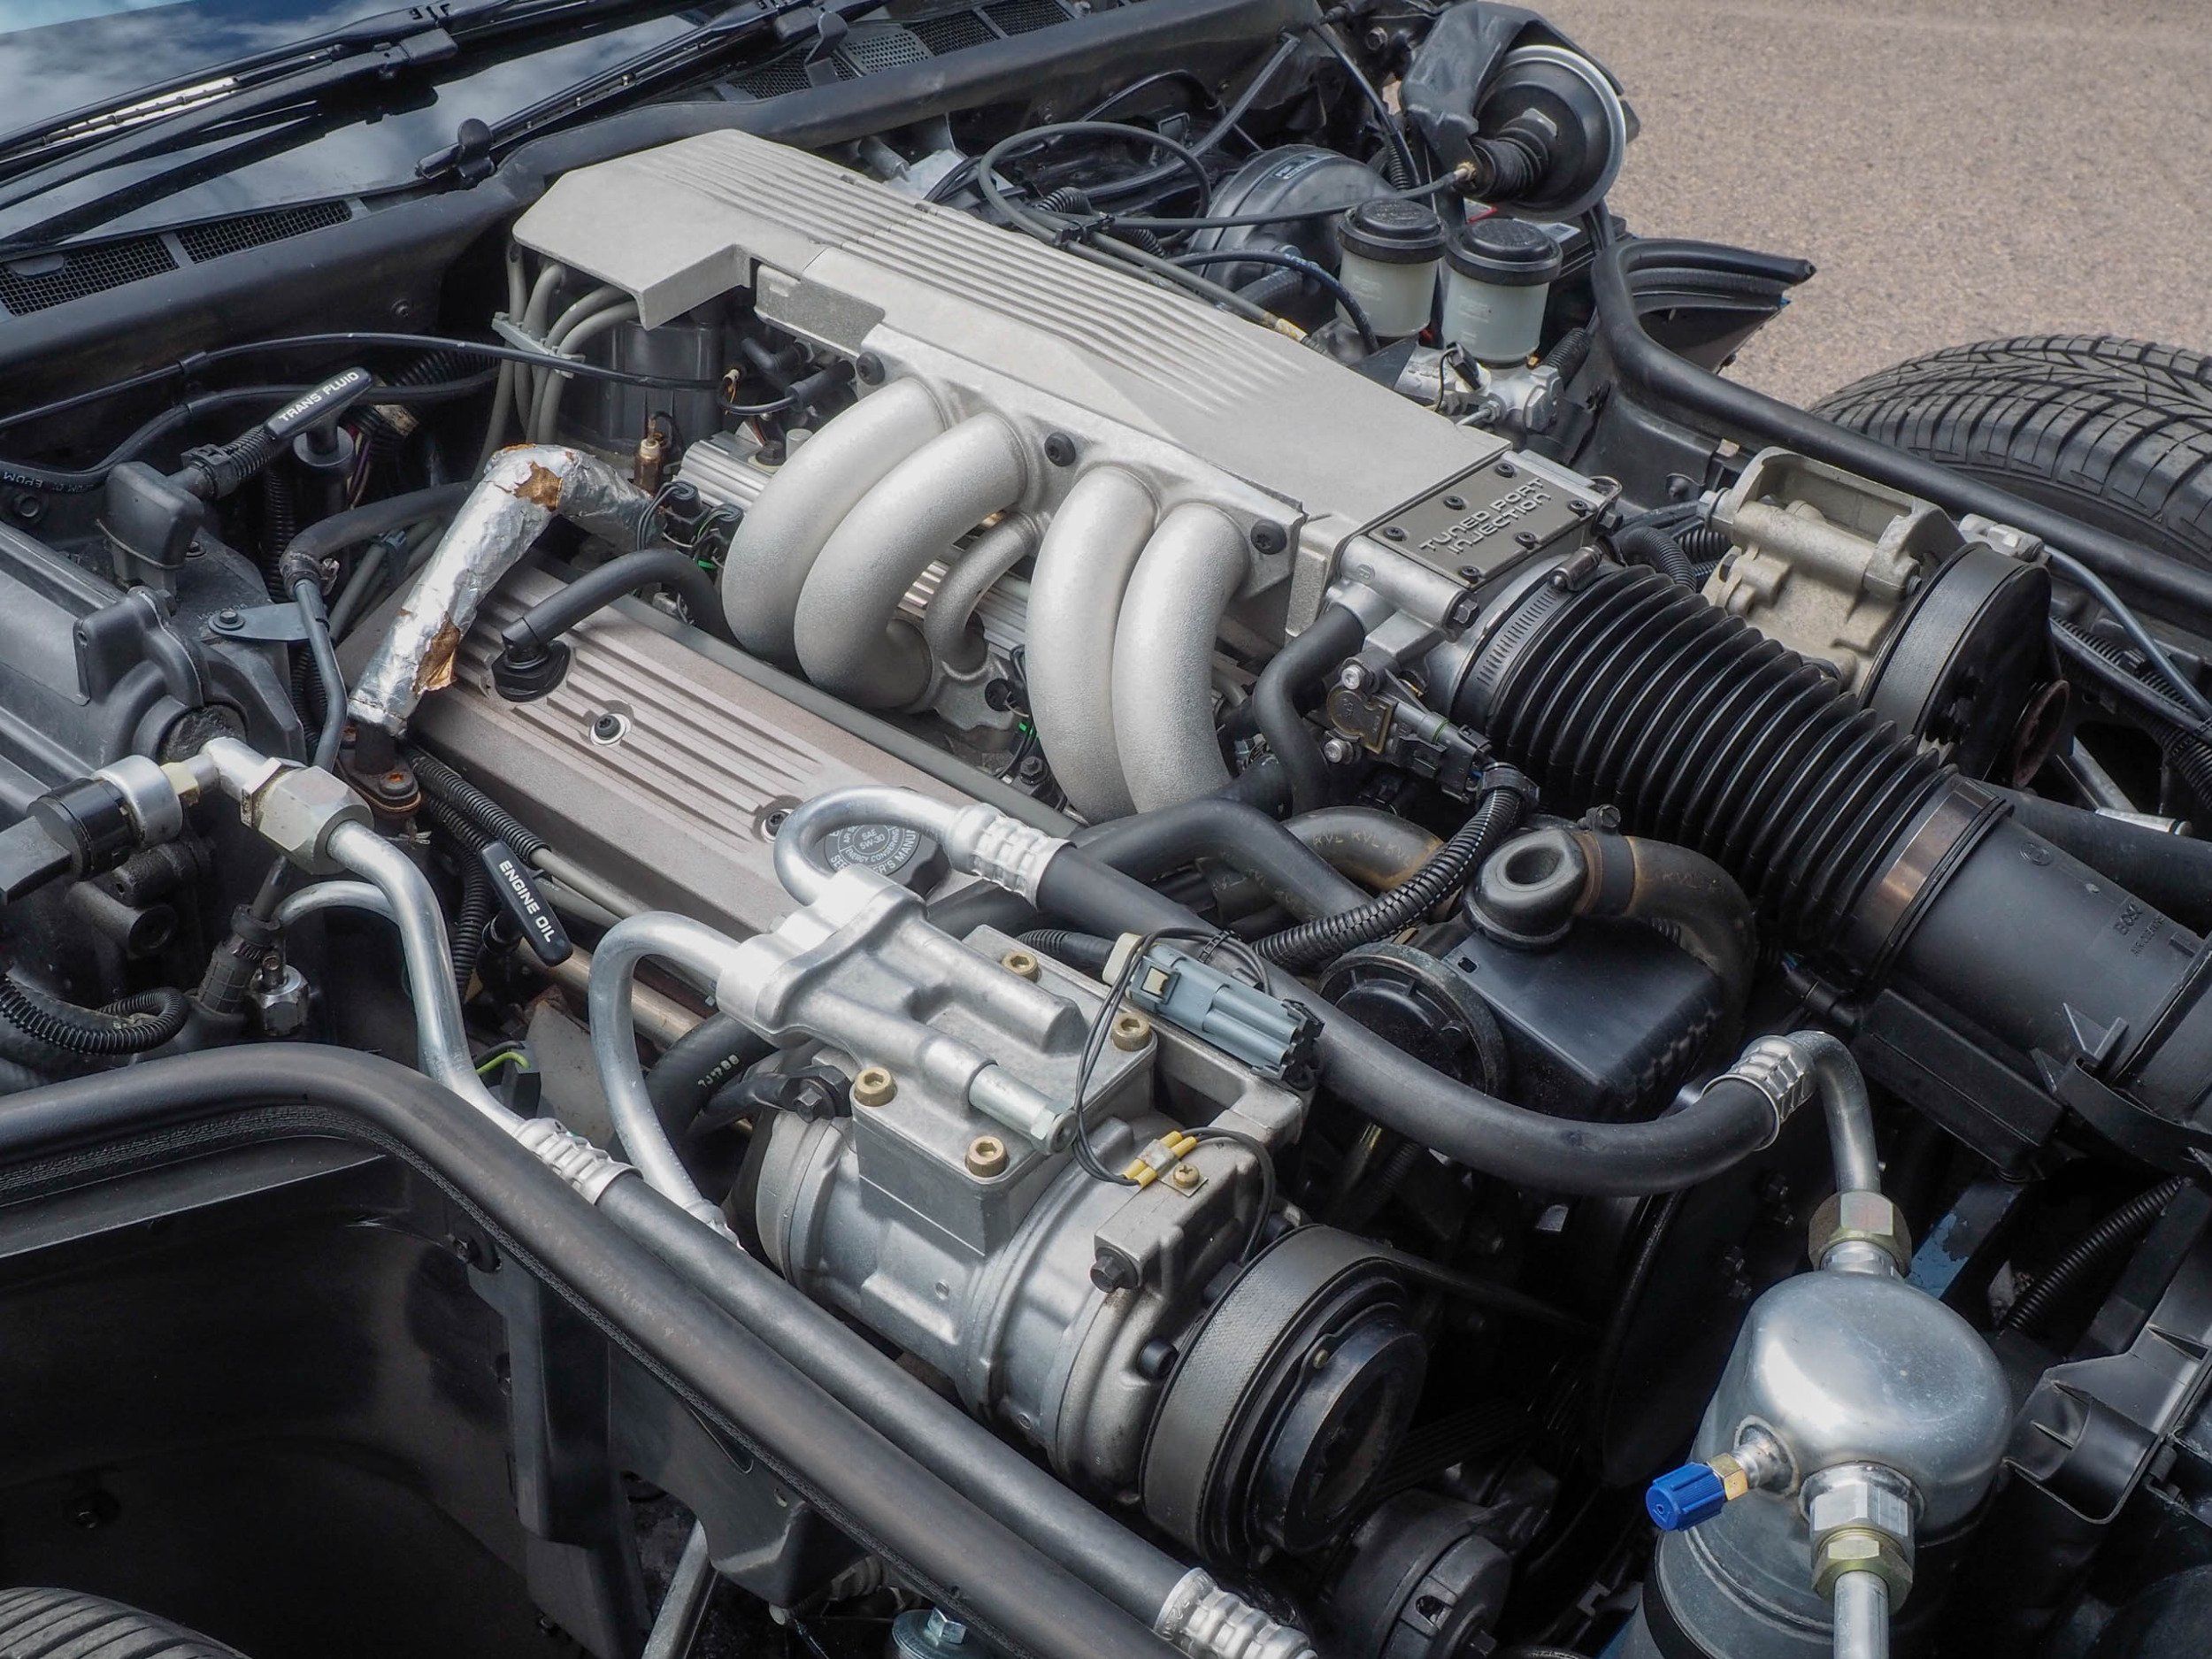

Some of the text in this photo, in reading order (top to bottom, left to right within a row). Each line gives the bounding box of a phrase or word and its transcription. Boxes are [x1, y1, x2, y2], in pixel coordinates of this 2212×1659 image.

[278, 371, 359, 421] TRANS FLUID
[1420, 478, 1544, 552] TUNED PORT
[1448, 492, 1552, 555] INJECTION
[861, 828, 878, 841] SAE
[499, 860, 541, 915] ENGINE
[535, 916, 555, 943] OIL
